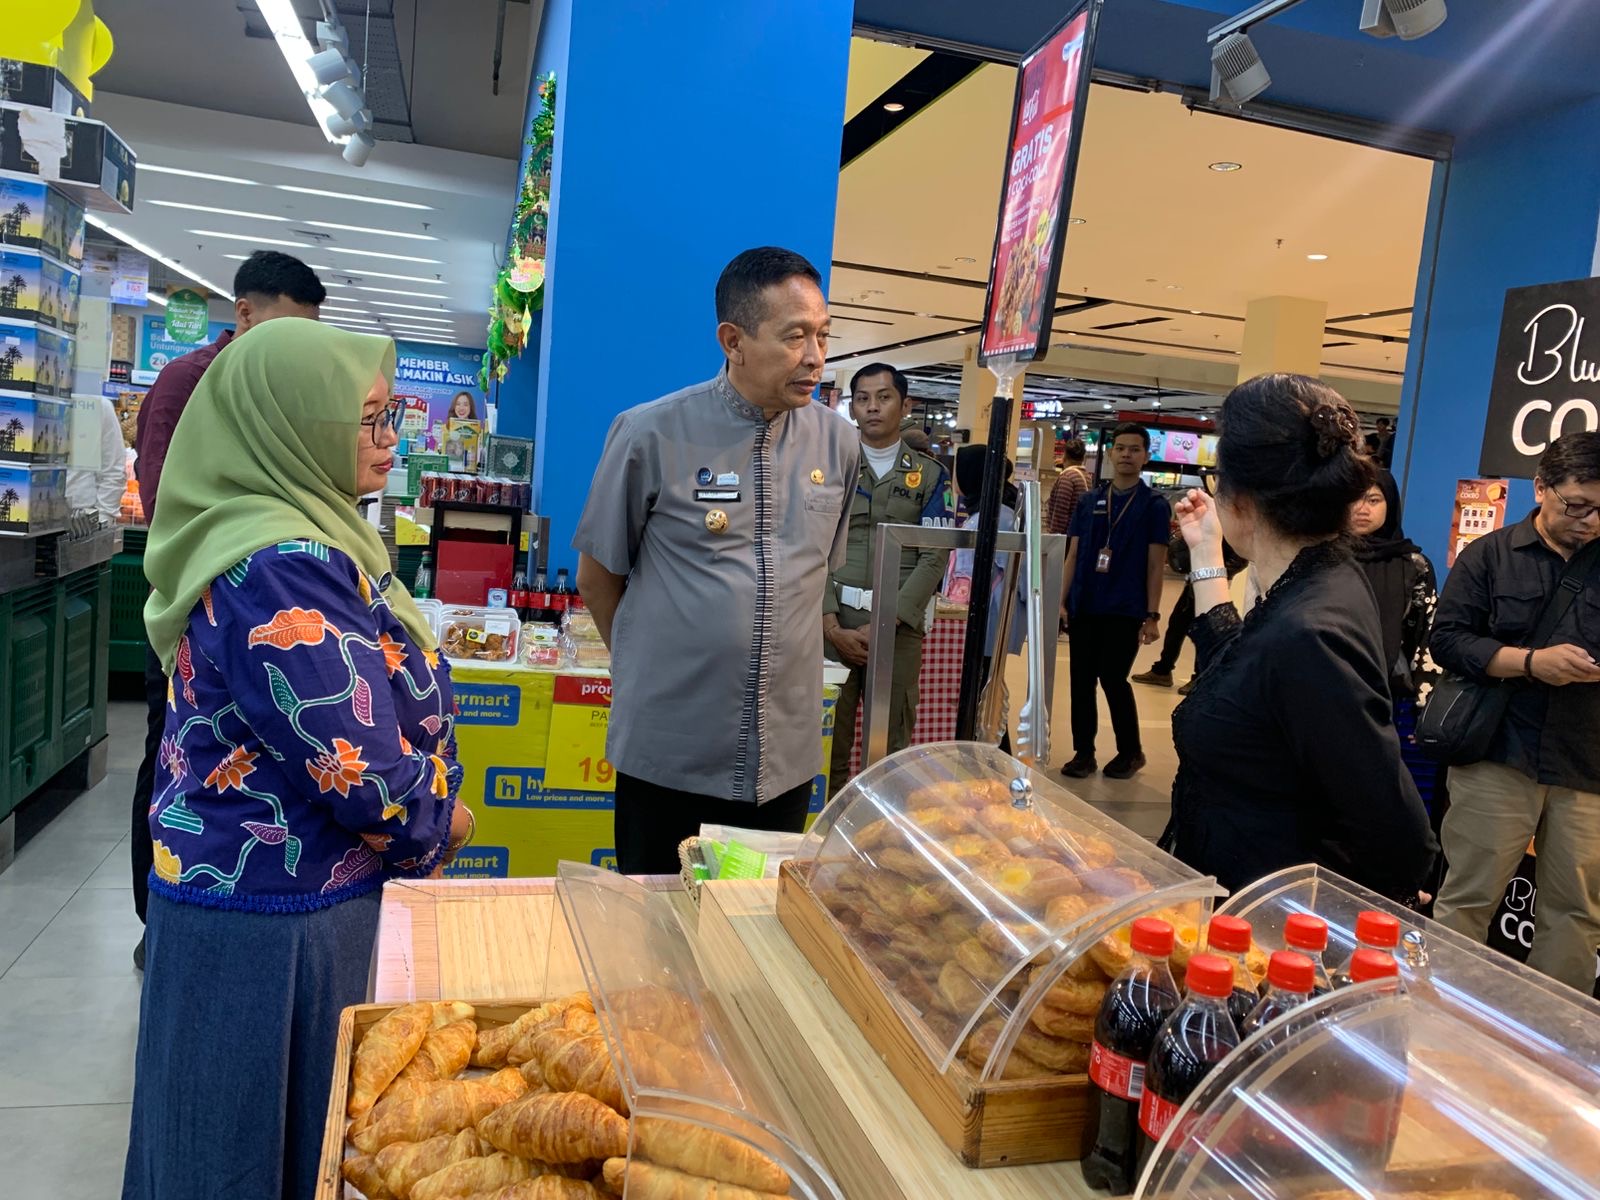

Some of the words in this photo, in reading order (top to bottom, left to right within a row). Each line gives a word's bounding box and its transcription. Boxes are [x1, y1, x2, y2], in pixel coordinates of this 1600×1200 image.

[1011, 124, 1053, 177] GRATIS
[400, 357, 449, 372] MEMBER
[403, 368, 443, 382] MAKIN
[446, 372, 476, 386] ASIK
[893, 486, 911, 499] POL
[544, 794, 567, 802] prices
